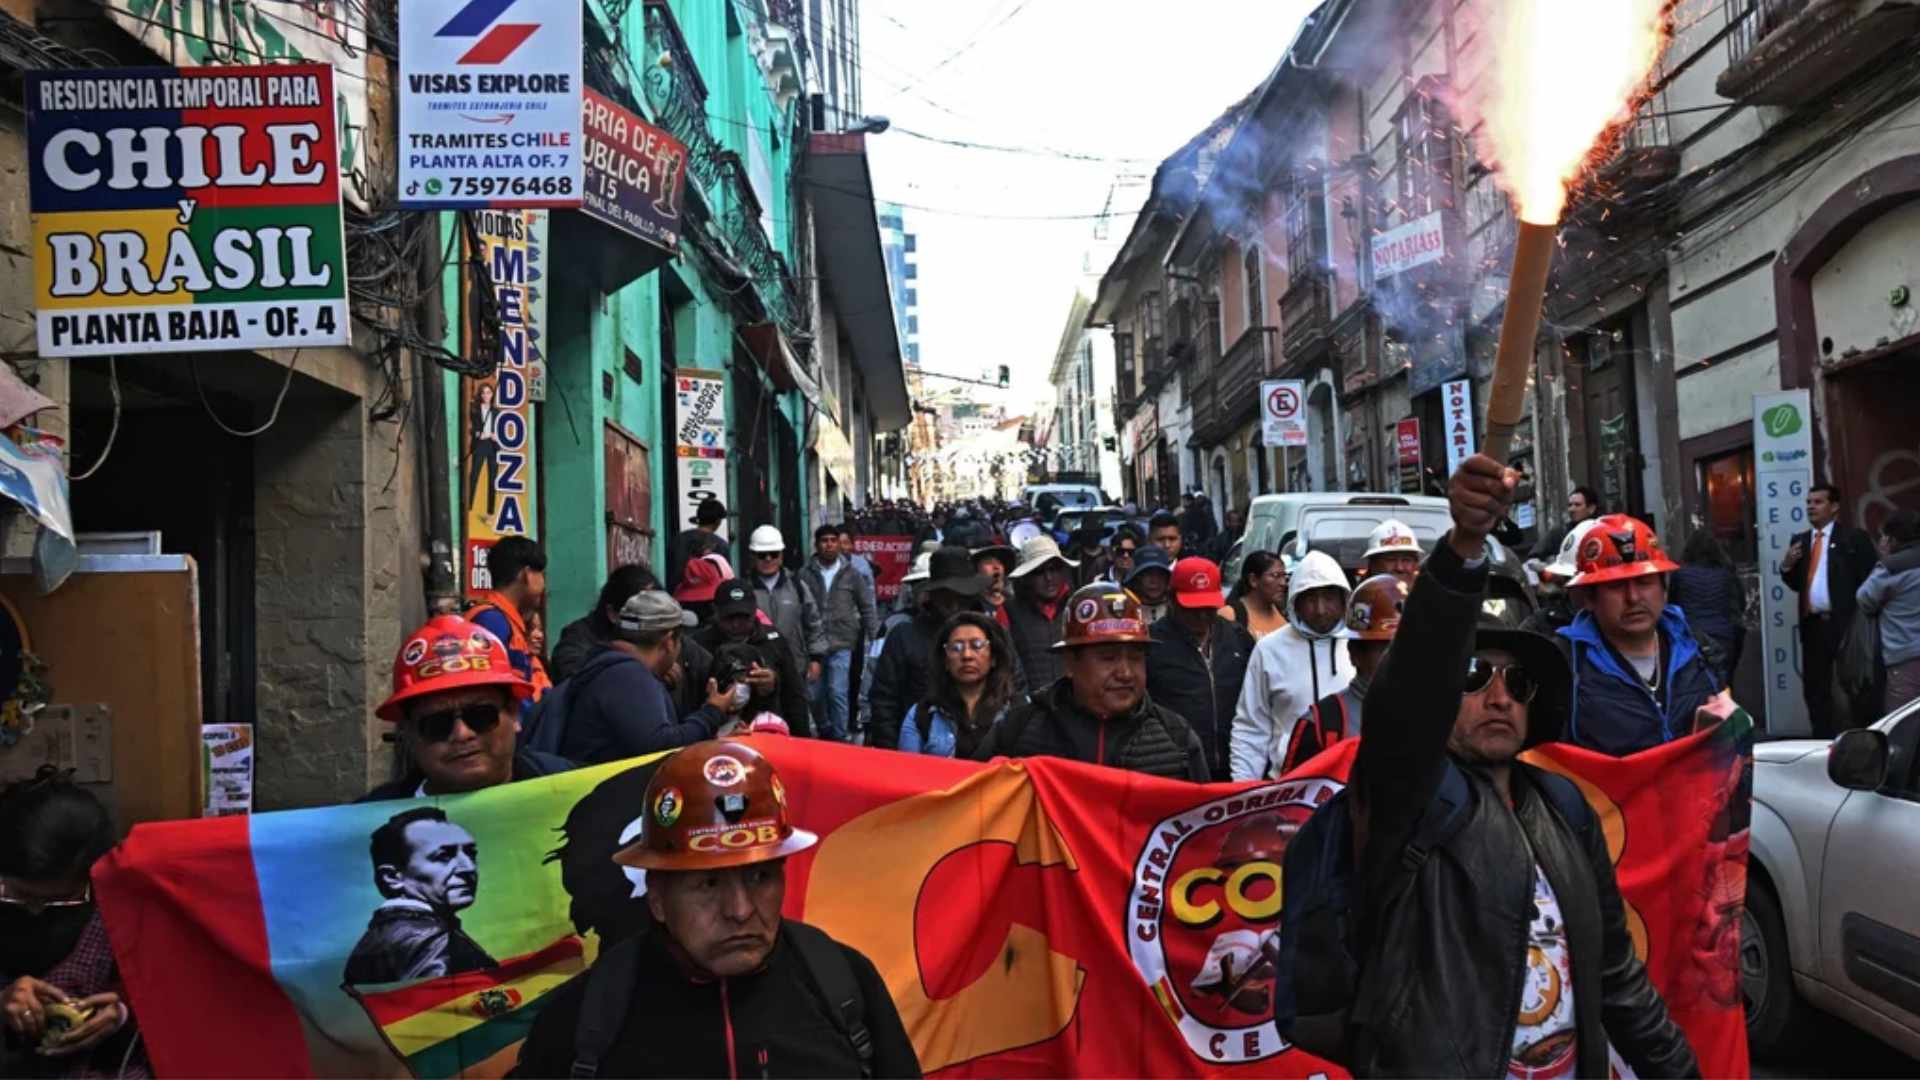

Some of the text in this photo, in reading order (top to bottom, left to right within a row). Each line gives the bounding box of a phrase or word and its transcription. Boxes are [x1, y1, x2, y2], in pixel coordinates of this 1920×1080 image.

[40, 75, 321, 111] RESIDENCIA TEMPORAL PARA
[408, 73, 570, 94] VISAS EXPLORE
[409, 132, 571, 149] TRAMITES CHILE
[582, 97, 658, 160] ARIA DE
[43, 122, 326, 191] CHILE
[409, 154, 569, 169] PLANTA ALTA OF. 7
[582, 133, 651, 194] UBLICA
[449, 176, 573, 196] 75976468
[599, 173, 618, 201] 15
[177, 198, 197, 224] y
[607, 202, 622, 220] DEL
[48, 225, 332, 297] BRASIL
[51, 312, 164, 347] PLANTA
[168, 309, 241, 342] BAJA
[264, 306, 309, 338] OF.
[316, 305, 337, 335] 4
[493, 243, 527, 533] MENDOZA
[1448, 382, 1469, 458] NOTARI
[1766, 481, 1785, 628] SELLOS
[418, 655, 492, 678] COB
[1774, 647, 1788, 690] DE
[688, 825, 778, 852] COB
[1136, 820, 1193, 942] CENTRAL
[1203, 784, 1308, 822] OBRERA
[1170, 861, 1283, 926] CO
